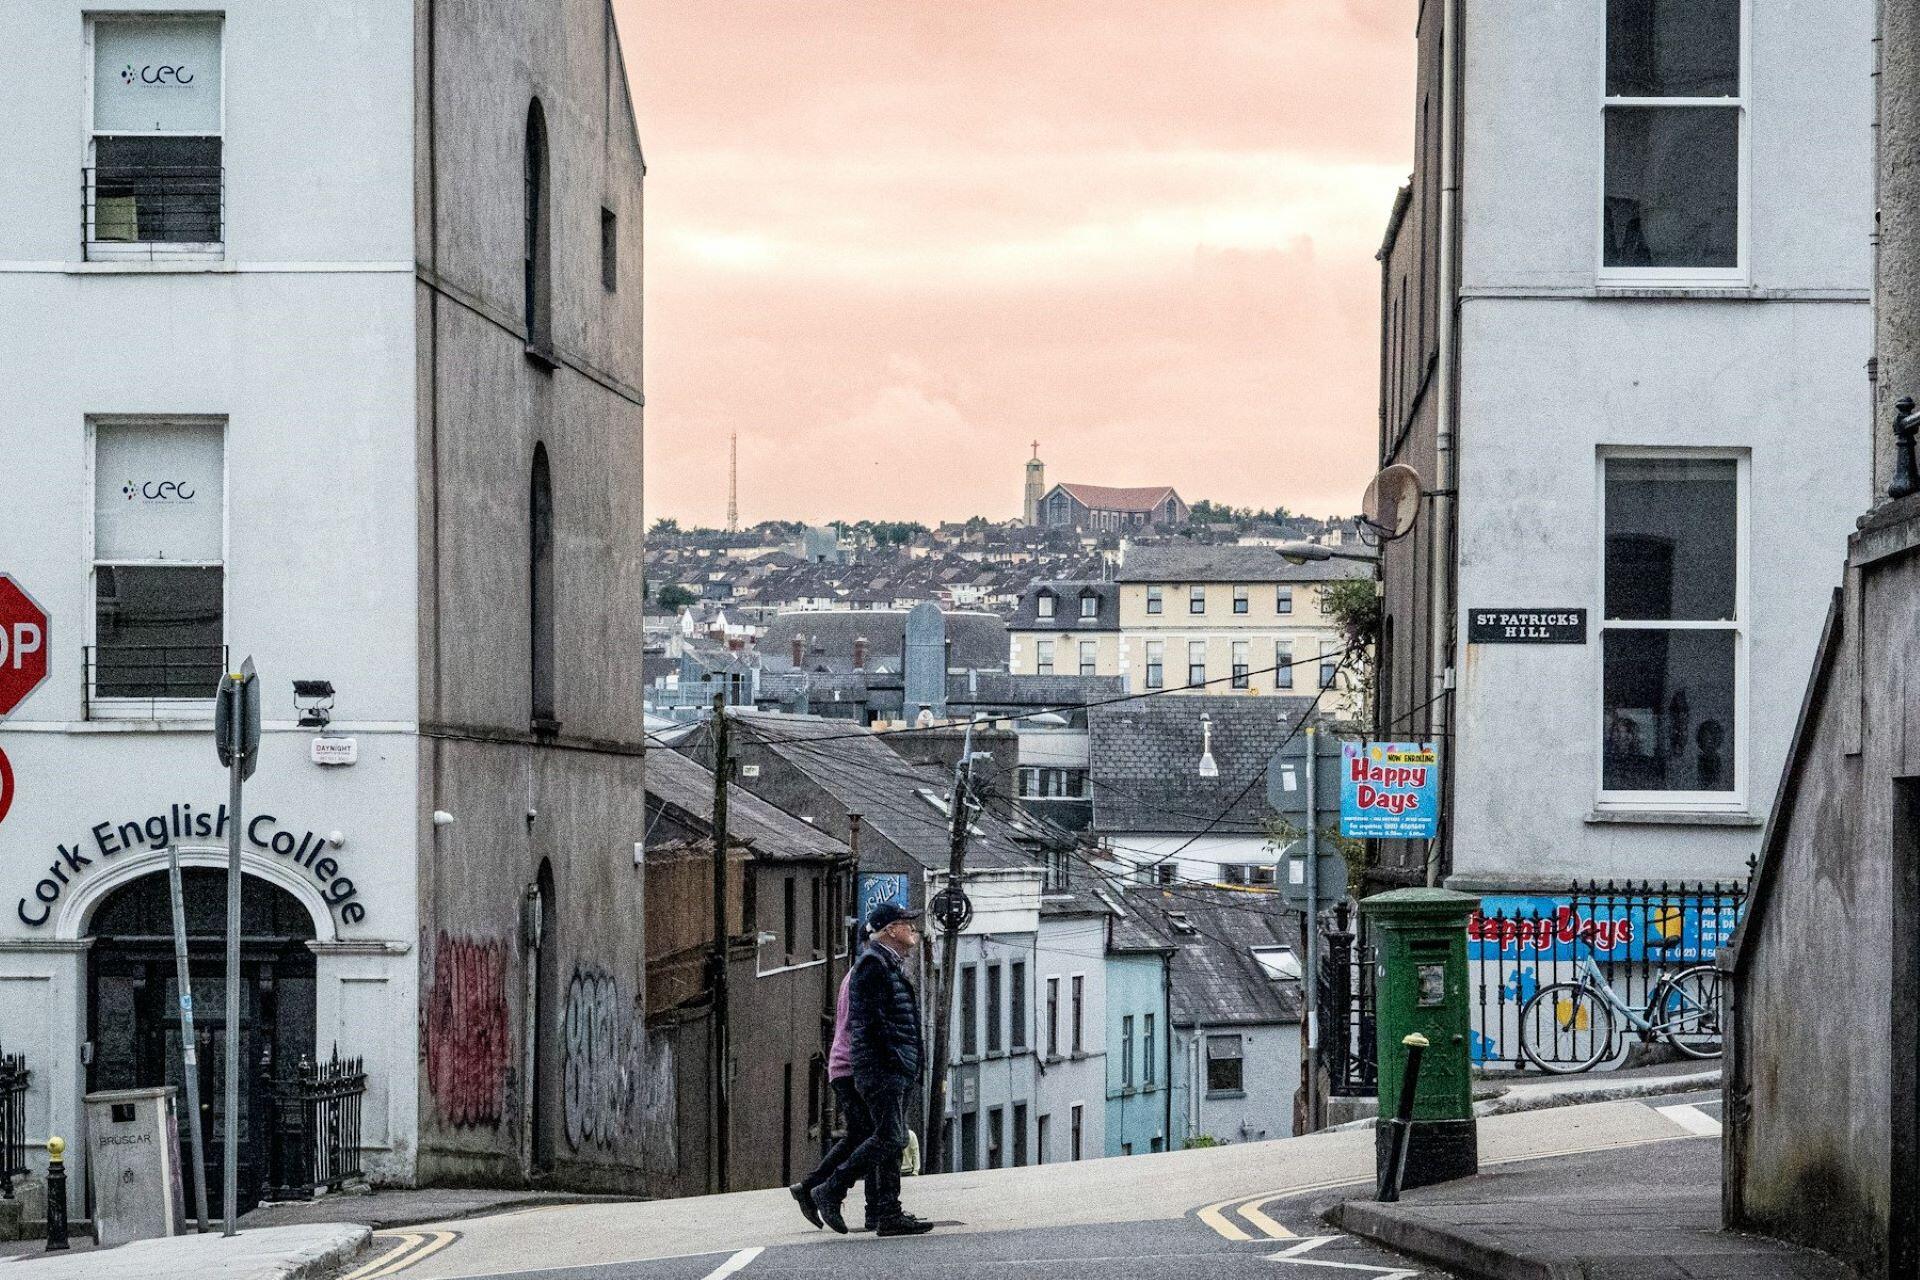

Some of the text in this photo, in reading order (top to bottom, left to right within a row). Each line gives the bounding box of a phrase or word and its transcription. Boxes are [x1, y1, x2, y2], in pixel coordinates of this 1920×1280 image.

[1477, 614, 1579, 625] ST PATRICKS
[1505, 626, 1550, 638] HILL
[1350, 757, 1427, 788] Happy
[1357, 783, 1419, 815] Days
[18, 843, 93, 927] Cork
[247, 814, 366, 925] College
